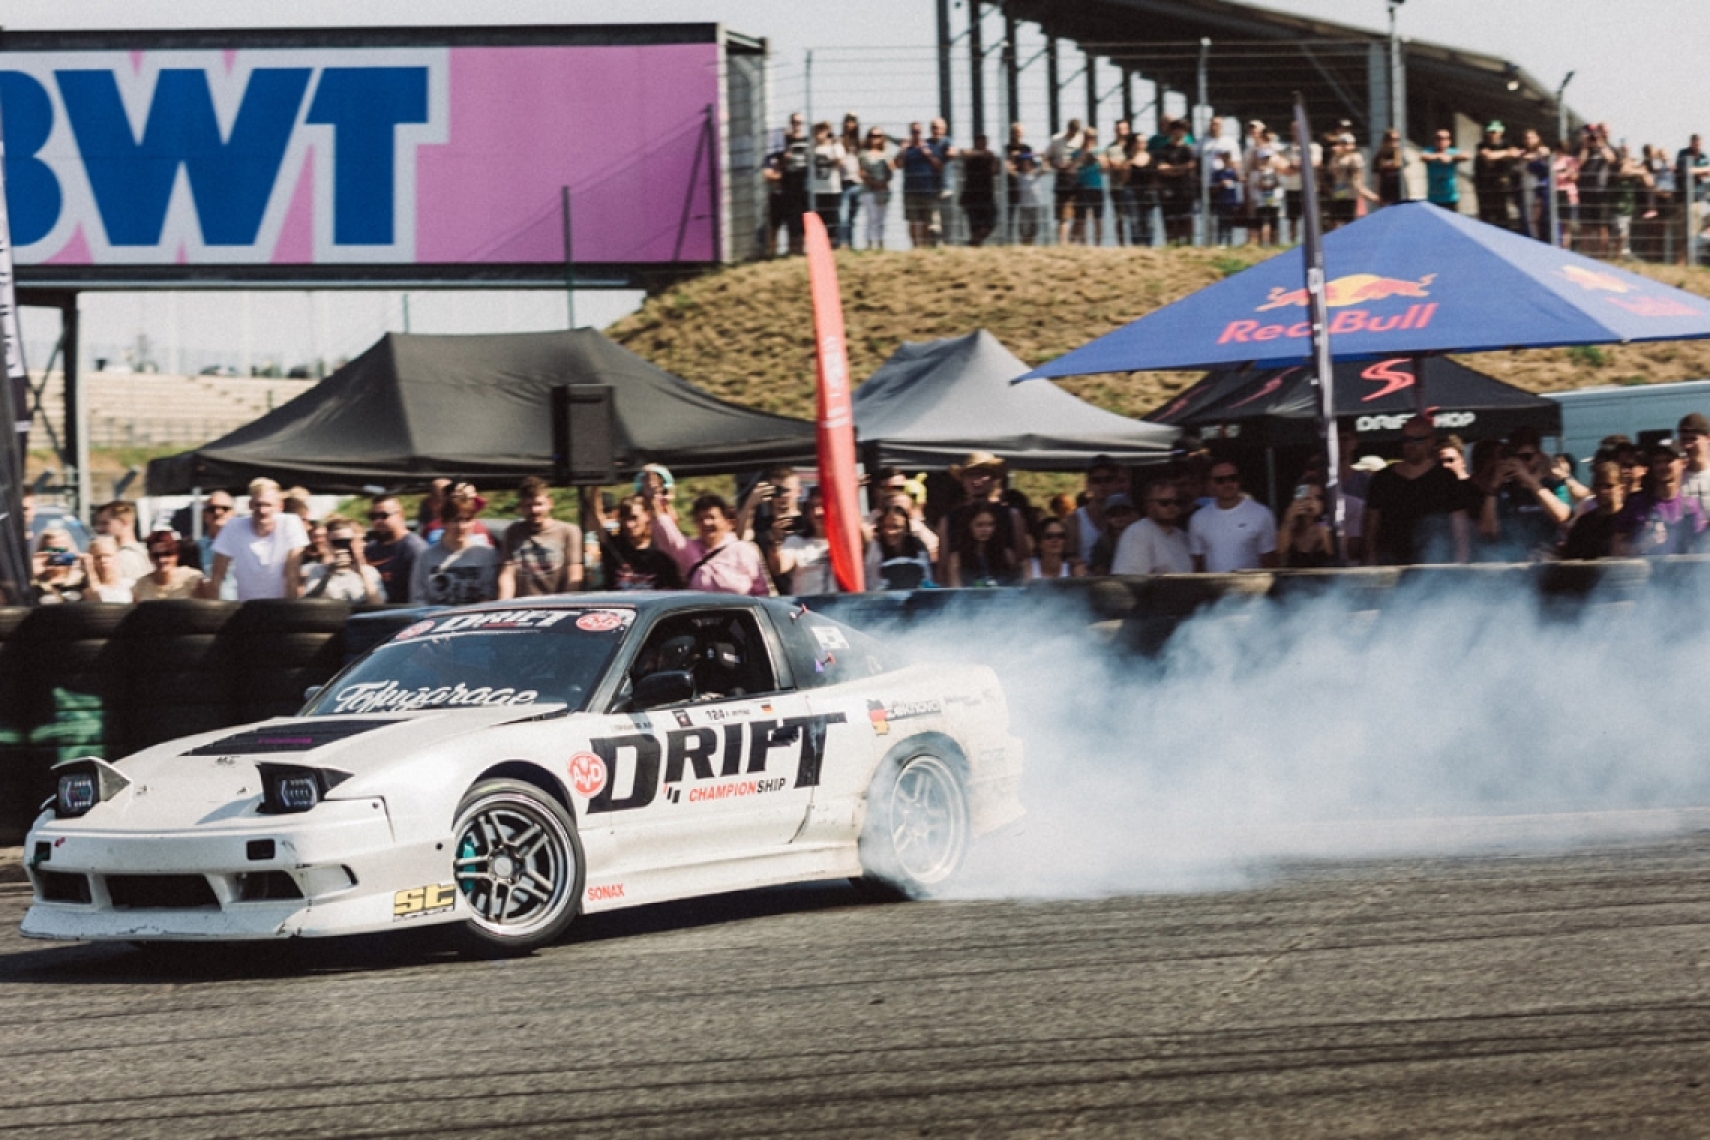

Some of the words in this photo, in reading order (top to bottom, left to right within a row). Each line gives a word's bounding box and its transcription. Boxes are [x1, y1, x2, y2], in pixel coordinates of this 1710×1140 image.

[1, 66, 429, 246] BWT
[1327, 303, 1439, 334] Bull
[585, 712, 848, 816] DRIFT
[689, 777, 787, 802] CHAMPIONSHIP
[587, 884, 624, 901] SONAX
